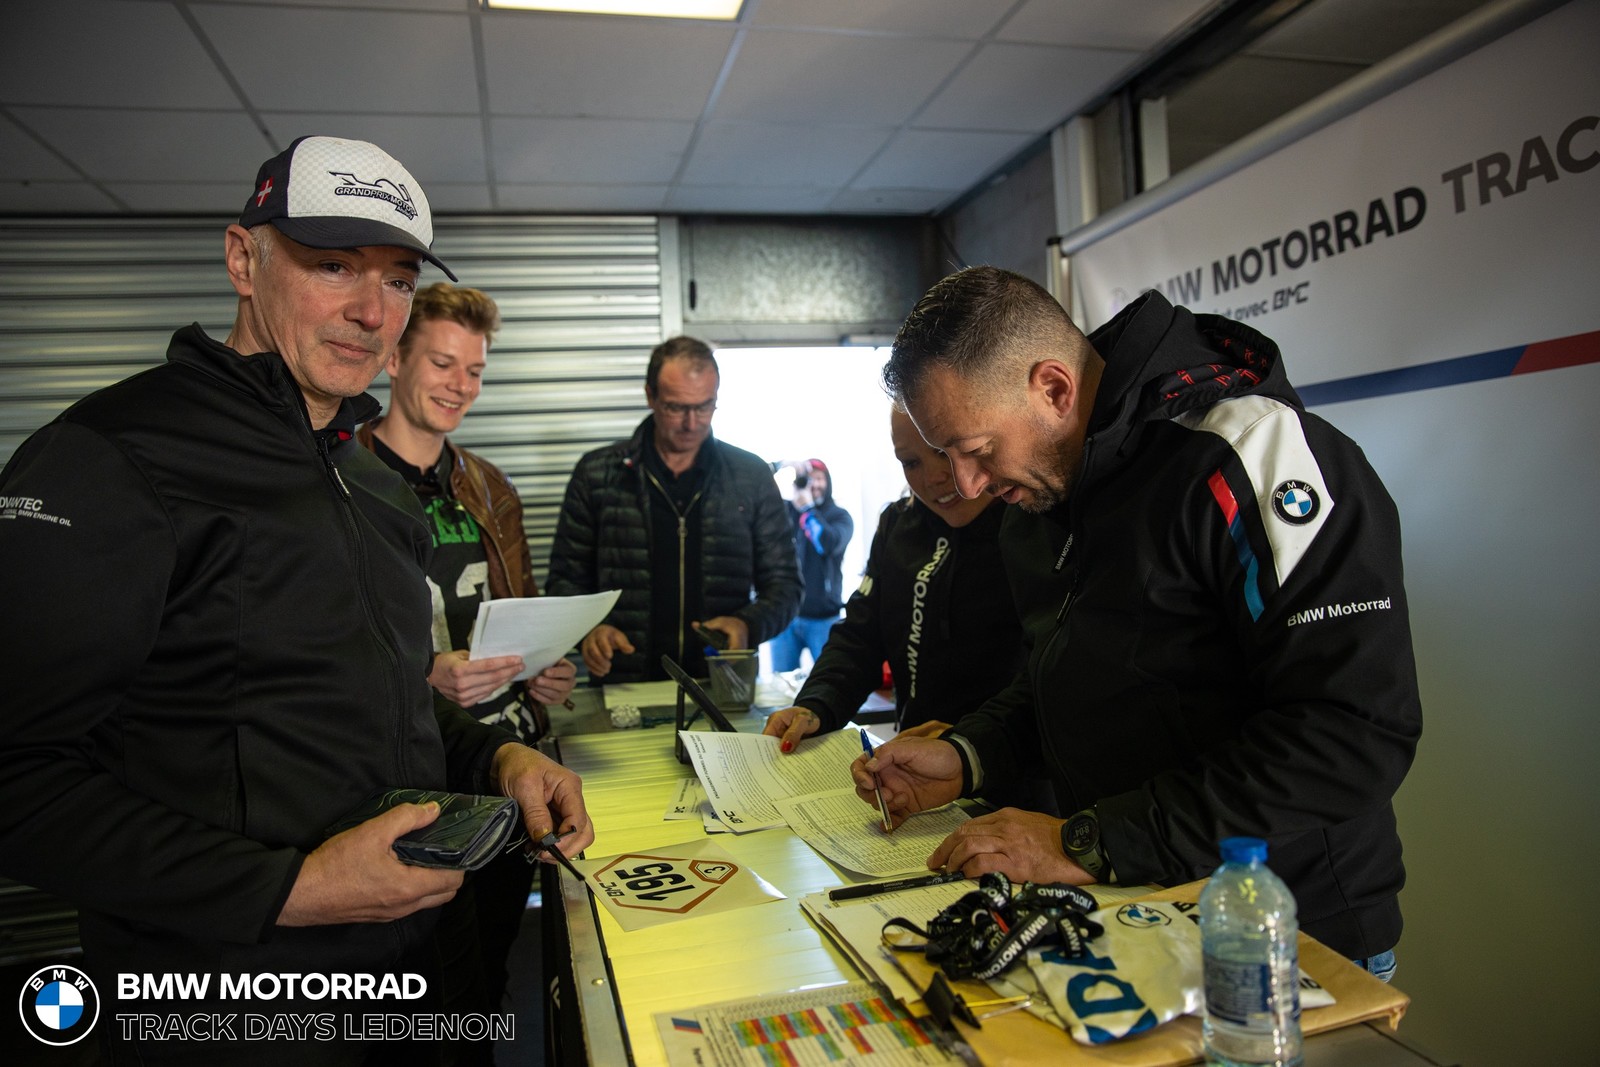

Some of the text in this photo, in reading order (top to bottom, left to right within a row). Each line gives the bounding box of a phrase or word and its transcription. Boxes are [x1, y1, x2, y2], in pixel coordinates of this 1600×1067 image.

[1138, 266, 1202, 310] MW
[1212, 186, 1428, 296] MOTORRAD
[1233, 300, 1270, 322] avec
[1275, 481, 1313, 500] BMW
[33, 512, 58, 523] ENGINE
[59, 518, 72, 527] OIL
[1287, 597, 1392, 627] BMW Motorrad
[613, 862, 696, 902] 195
[703, 866, 726, 875] 3
[1019, 914, 1048, 946] BMW
